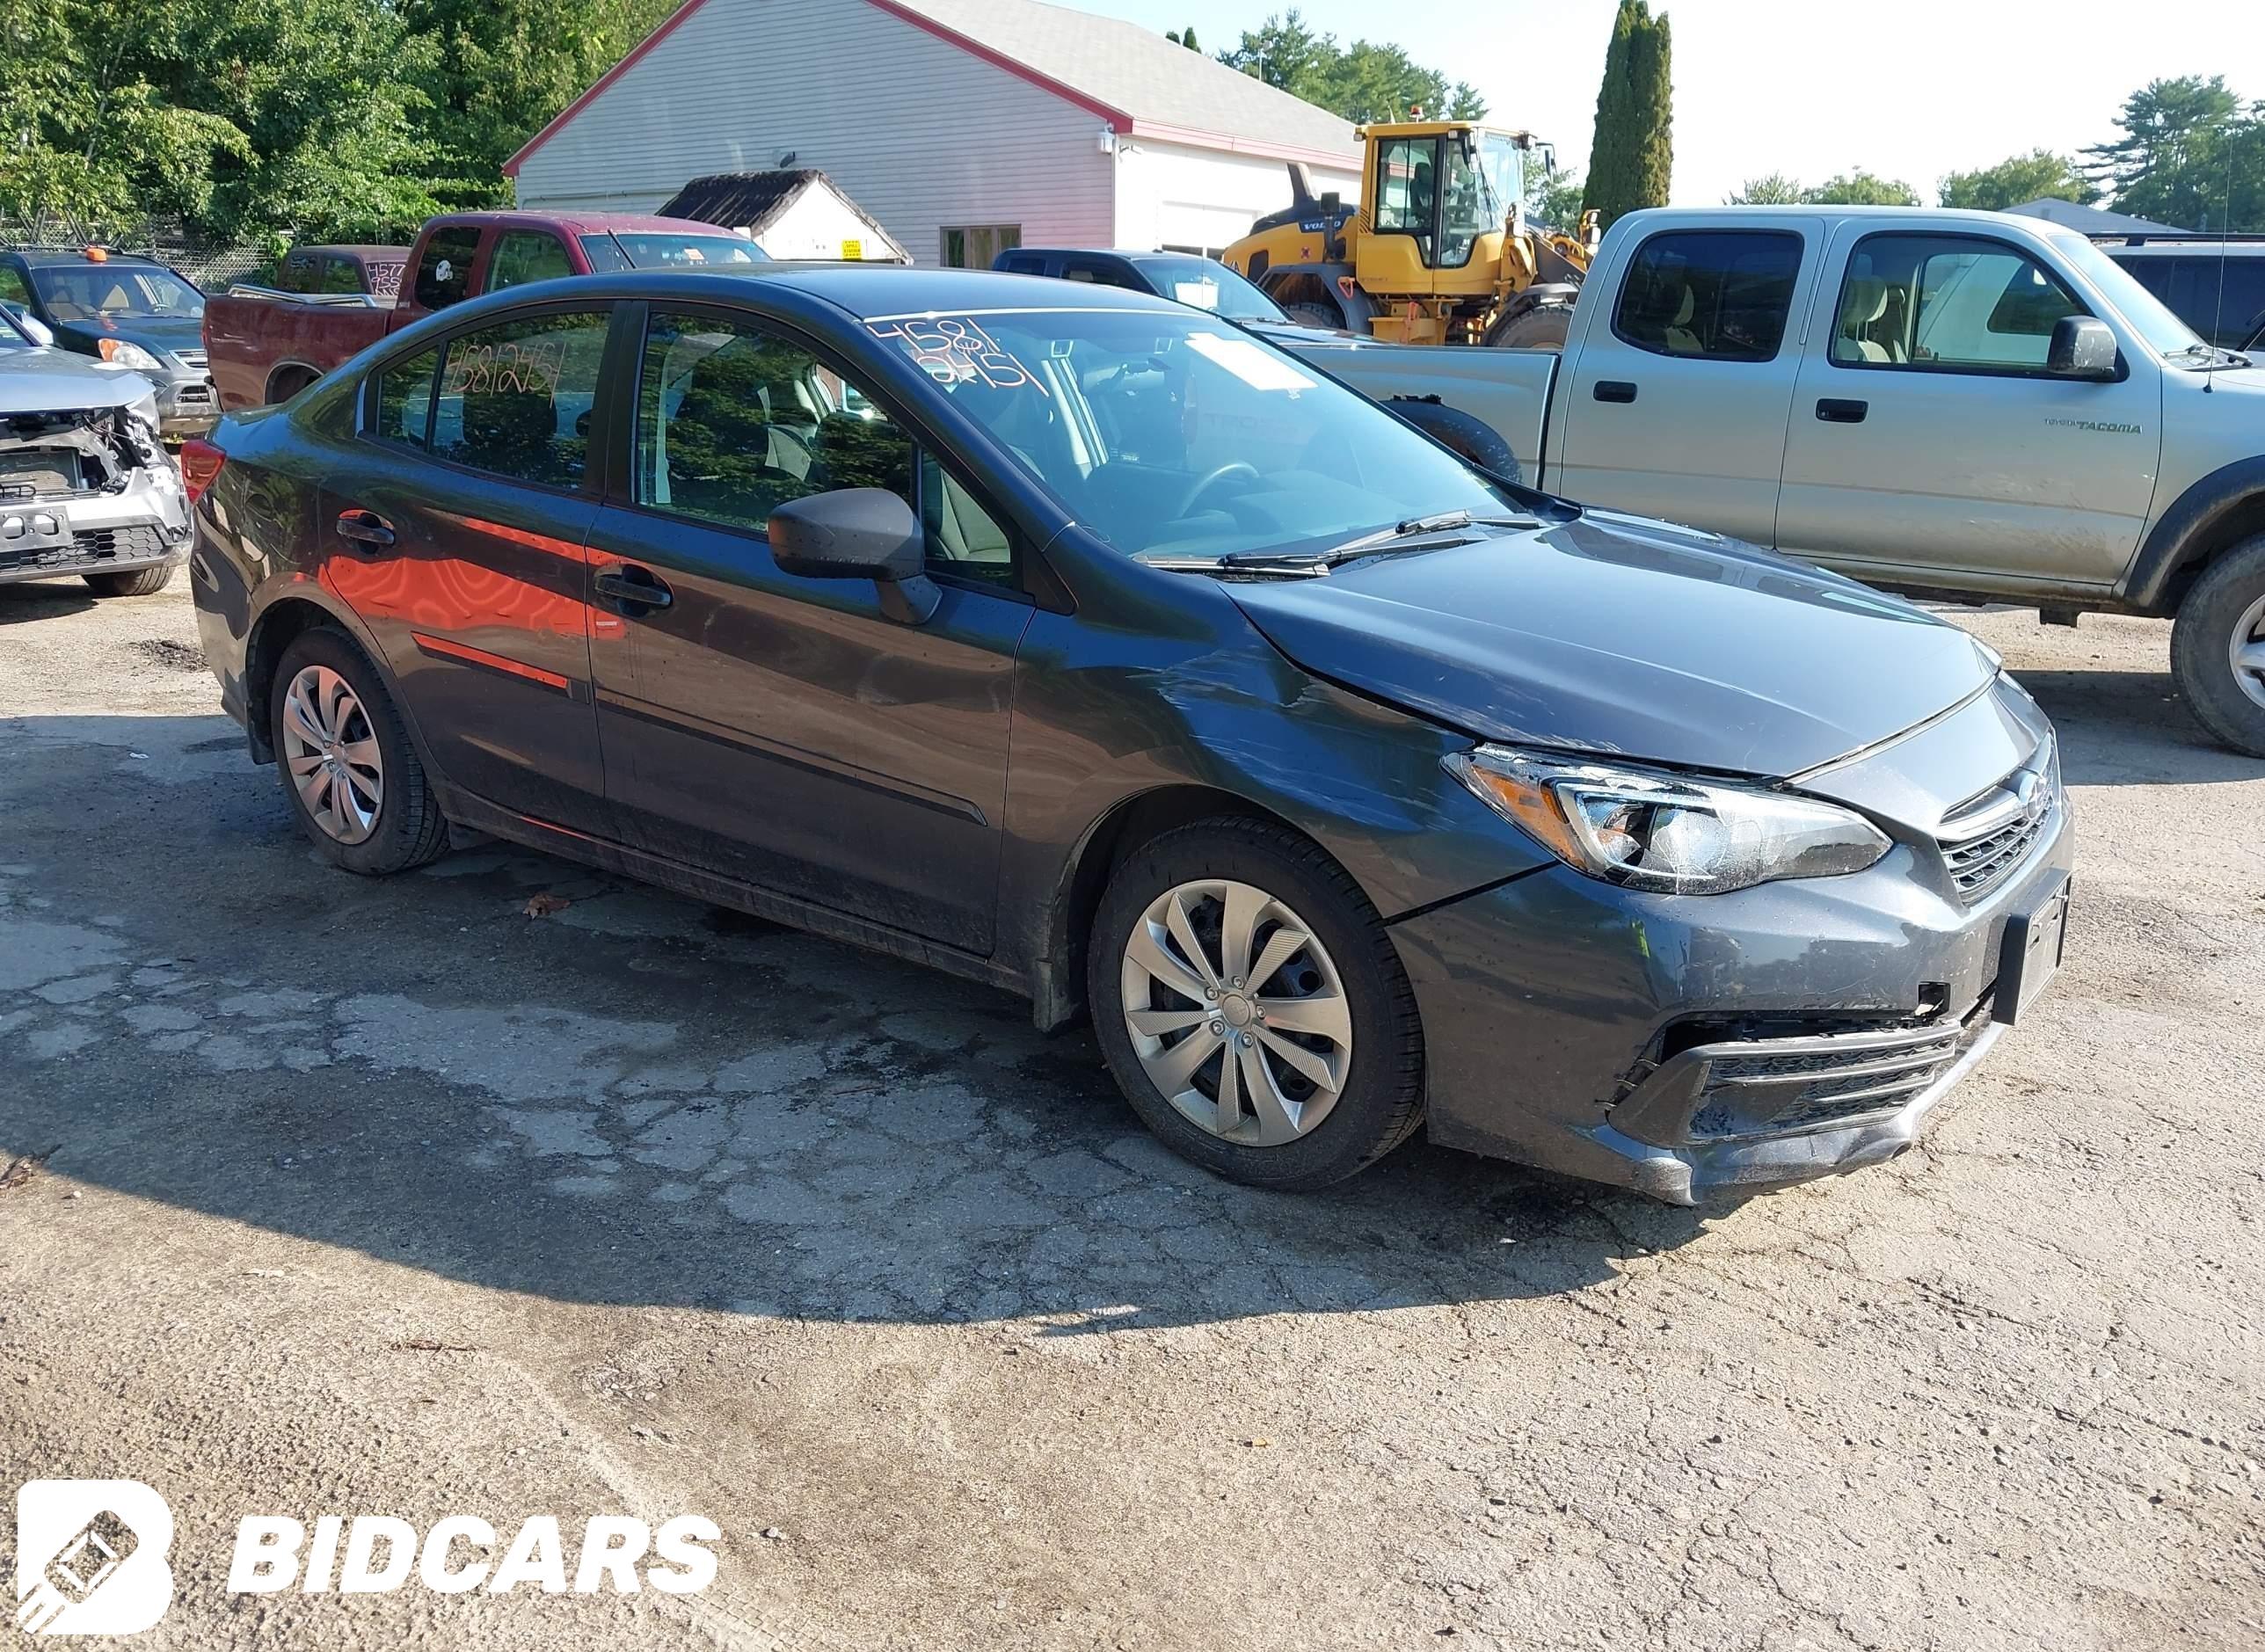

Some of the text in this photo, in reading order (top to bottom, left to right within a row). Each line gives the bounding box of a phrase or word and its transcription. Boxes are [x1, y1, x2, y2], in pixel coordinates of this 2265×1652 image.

[1304, 221, 1342, 230] VOLO
[368, 264, 406, 277] 4577
[371, 277, 403, 289] 955
[866, 317, 1001, 353] 4581
[447, 342, 567, 409] 45812451
[916, 352, 1050, 397] 2451
[2078, 421, 2143, 434] TACOMA
